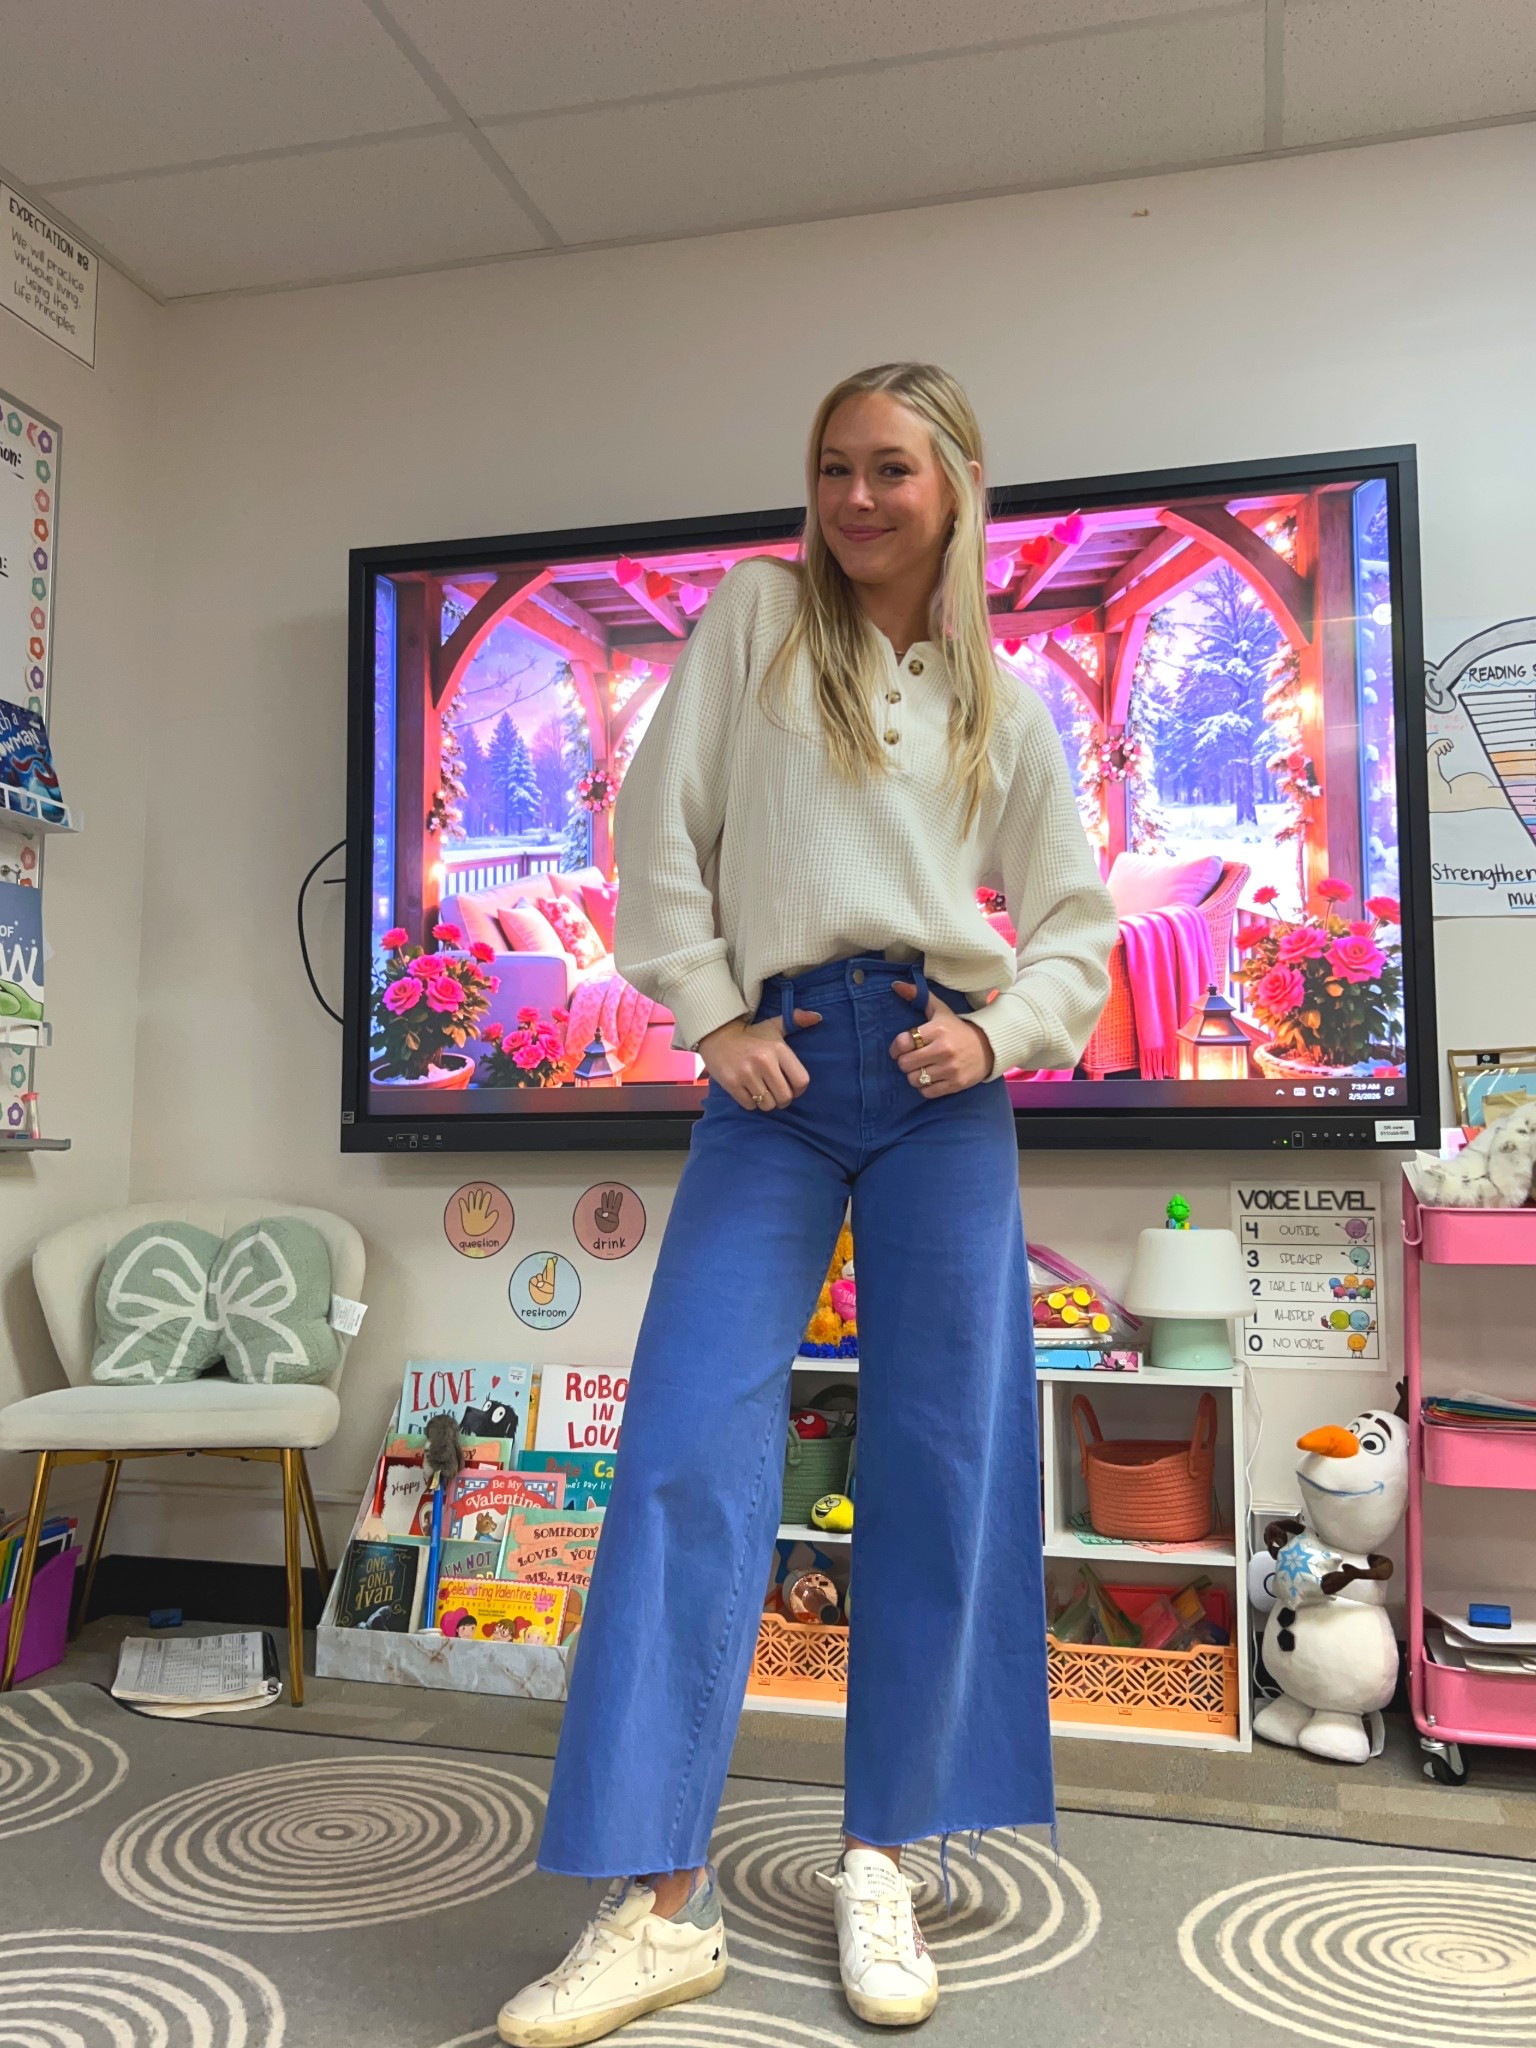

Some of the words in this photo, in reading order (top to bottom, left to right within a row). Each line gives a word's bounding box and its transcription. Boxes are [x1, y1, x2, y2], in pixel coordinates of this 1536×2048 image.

[9, 197, 74, 260] EXPECTATION
[77, 251, 89, 271] #8
[11, 227, 28, 249] We
[47, 258, 85, 293] practice
[14, 249, 54, 287] virtuous
[14, 281, 32, 304] Life
[26, 274, 50, 300] using
[53, 295, 69, 315] the
[1468, 663, 1527, 682] READING
[1508, 892, 1536, 908] mu
[1238, 1190, 1300, 1210] VOICE
[1304, 1191, 1376, 1211] LEVEL
[1246, 1222, 1259, 1239] 4
[1279, 1225, 1320, 1237] OUTSIDE
[459, 1237, 500, 1251] question
[593, 1238, 626, 1250] drink
[1247, 1250, 1259, 1267] 3
[1280, 1253, 1322, 1266] SPEAKER
[1249, 1279, 1261, 1296] 2
[1269, 1280, 1296, 1293] TABLE
[1301, 1281, 1325, 1293] TALK
[521, 1308, 567, 1318] restroom
[1274, 1309, 1315, 1322] WHISPER
[1249, 1335, 1263, 1351] 0
[1273, 1338, 1291, 1349] NO
[1295, 1339, 1325, 1351] VOICE
[411, 1368, 476, 1413] LOVE
[593, 1403, 615, 1421] IN
[391, 1480, 420, 1496] Happy
[492, 1479, 505, 1489] Be
[507, 1480, 523, 1490] My
[533, 1525, 600, 1540] SOMEBODY
[366, 1556, 387, 1574] ONE
[466, 1551, 492, 1570] NOT
[517, 1546, 559, 1568] LOVES
[570, 1548, 596, 1561] YOU
[367, 1570, 395, 1588] ONLY
[355, 1585, 394, 1612] Ivan
[446, 1581, 494, 1602] Celebrating
[495, 1584, 537, 1601] Valentine's
[540, 1588, 557, 1604] Day
